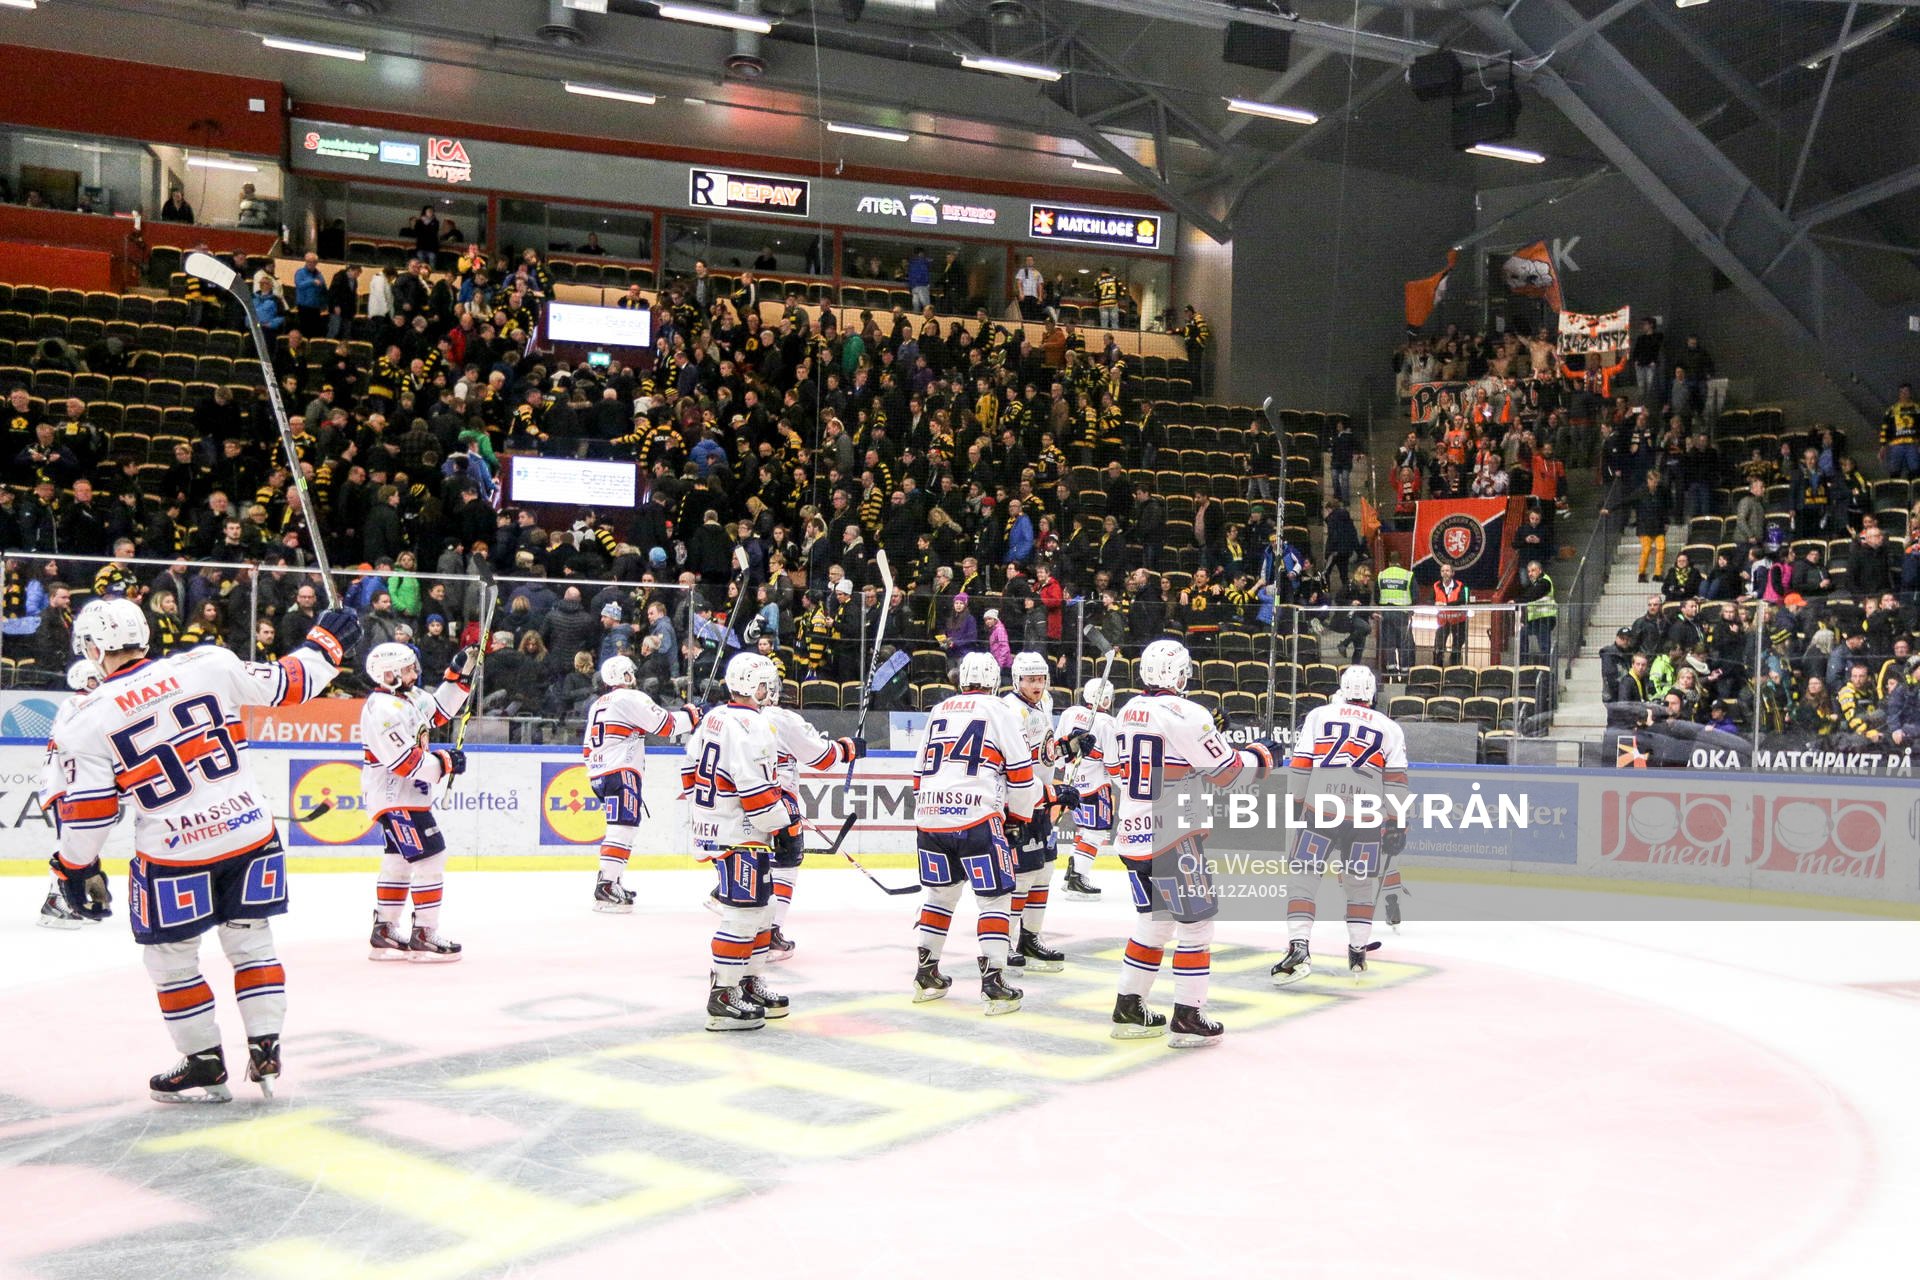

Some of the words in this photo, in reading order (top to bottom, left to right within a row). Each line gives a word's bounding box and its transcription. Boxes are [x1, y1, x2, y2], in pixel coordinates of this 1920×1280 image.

[427, 137, 470, 163] ICA
[426, 164, 472, 183] torget
[727, 181, 802, 207] REPAY
[857, 196, 907, 216] ATEA
[1057, 215, 1134, 238] MATCHLOGE
[114, 677, 181, 712] MAXI
[942, 700, 976, 711] MAXI
[1124, 708, 1150, 723] MAXI
[1340, 708, 1373, 721] MAXI
[259, 716, 343, 743] ÅBYNS
[389, 731, 405, 748] 9
[108, 692, 240, 812] 53
[922, 718, 989, 777] 64
[1320, 721, 1384, 779] 22
[1754, 748, 1882, 777] MATCHPAKET
[1888, 747, 1912, 777] PÅ
[165, 791, 255, 832] LARSSON
[181, 807, 264, 845] INTERSPORT
